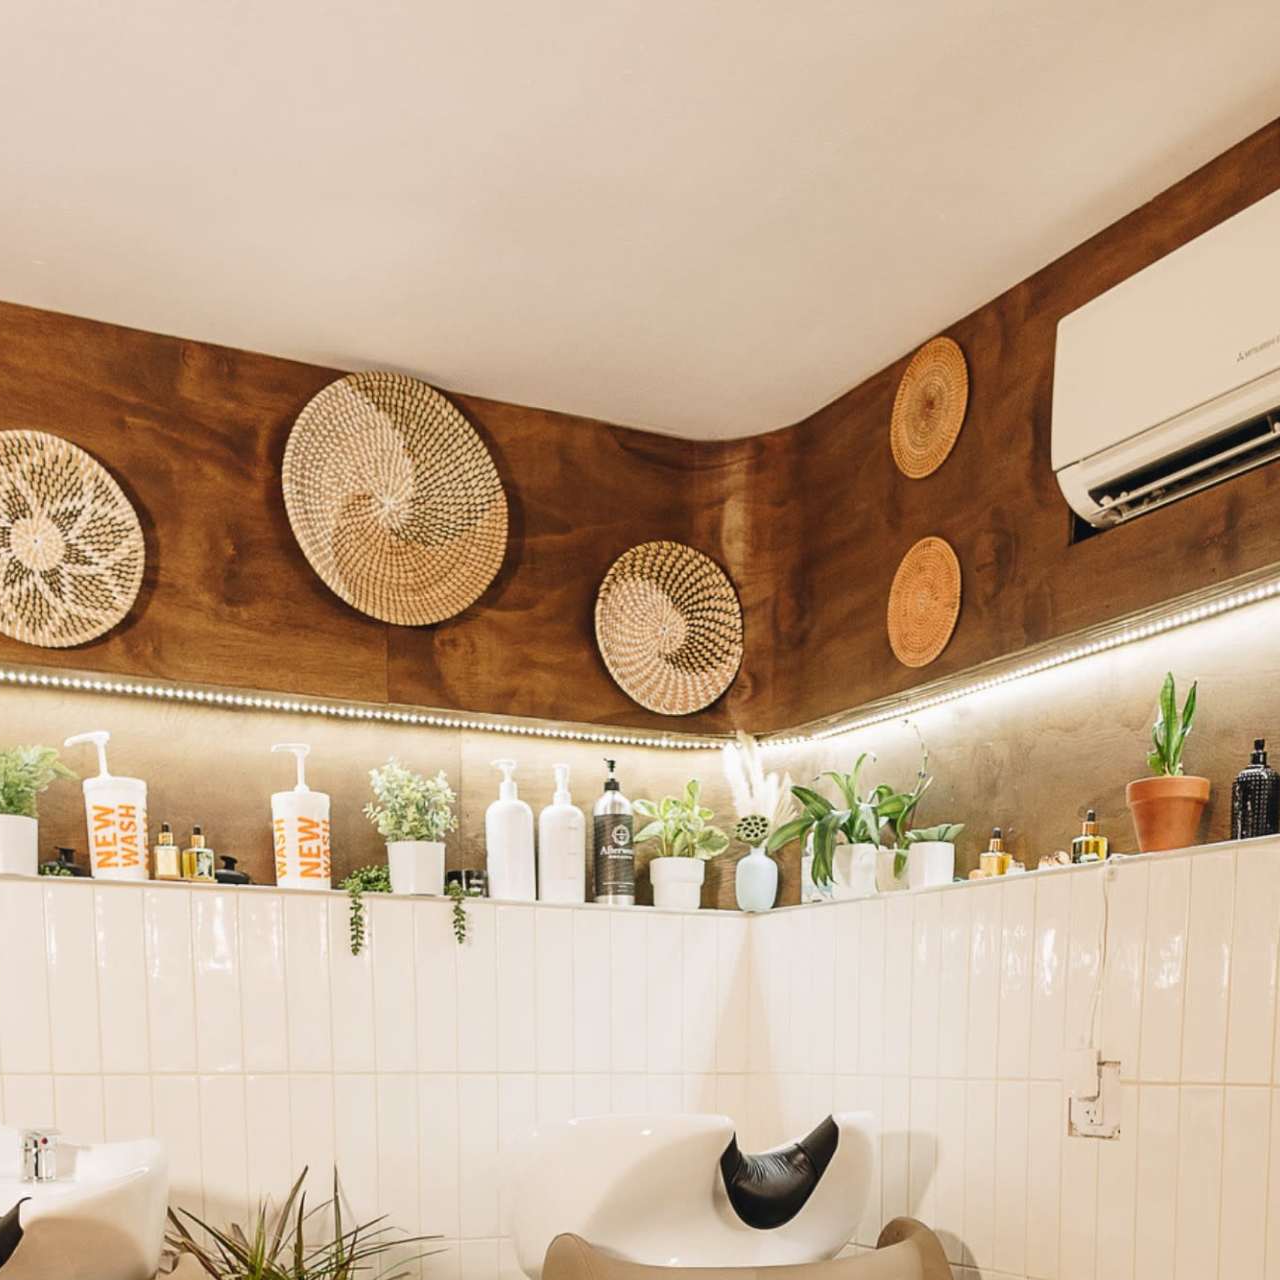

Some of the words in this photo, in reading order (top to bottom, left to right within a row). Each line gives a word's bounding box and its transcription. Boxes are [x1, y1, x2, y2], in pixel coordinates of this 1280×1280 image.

[93, 805, 119, 869] NEW
[117, 804, 140, 868] WASH
[297, 816, 322, 878] NEW
